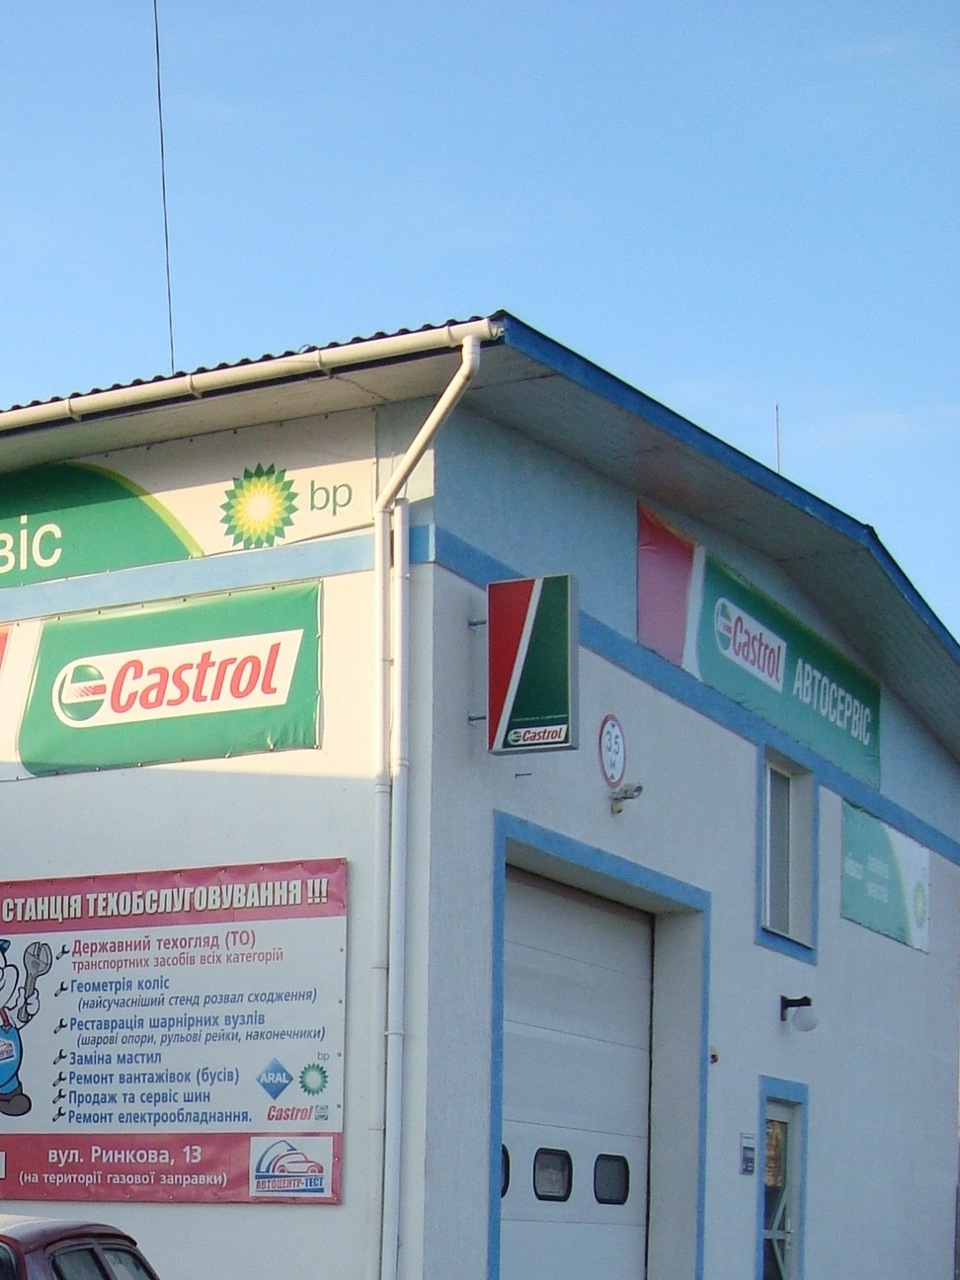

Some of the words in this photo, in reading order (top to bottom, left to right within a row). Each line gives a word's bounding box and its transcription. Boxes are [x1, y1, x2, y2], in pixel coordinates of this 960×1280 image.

[309, 478, 353, 517] bp
[733, 615, 781, 684] Castrol
[110, 642, 282, 713] Castrol
[793, 658, 872, 746] АВТОСЕРВІС
[521, 726, 562, 742] Castrol
[2, 894, 82, 923] СТАНЦІЯ
[86, 879, 302, 918] ТЕХОБСЛУГОВУВАННЯ
[72, 935, 151, 958] Державний
[156, 934, 220, 951] техогляд
[225, 930, 256, 951] (ТО)
[72, 957, 149, 975] транспортних
[153, 951, 196, 967] засобів
[200, 950, 222, 965] всіх
[226, 947, 284, 966] категорій
[70, 977, 133, 995] Геометрія
[137, 975, 170, 991] коліс
[77, 993, 165, 1012] (найсучасніший
[168, 994, 200, 1006] стенд
[203, 993, 244, 1008] розвал
[247, 987, 317, 1004] сходження)
[70, 1014, 144, 1033] Реставрація
[149, 1013, 219, 1031] шарнірних
[224, 1010, 266, 1029] вузлів
[77, 1032, 119, 1048] (шарові
[121, 1033, 157, 1047] опори,
[160, 1029, 202, 1046] рульові
[204, 1028, 242, 1045] рейки,
[245, 1026, 326, 1042] наконечники)
[69, 1050, 112, 1065] Заміна
[116, 1052, 162, 1065] мастил
[317, 1051, 330, 1061] bp
[69, 1070, 115, 1085] Ремонт
[118, 1069, 192, 1085] вантажівок
[196, 1067, 240, 1086] (бусів)
[259, 1071, 290, 1084] ARAL
[68, 1089, 118, 1107] Продаж
[122, 1092, 136, 1104] та
[140, 1088, 179, 1107] сервіс
[183, 1091, 211, 1103] шин
[68, 1109, 114, 1124] Ремонт
[118, 1108, 252, 1126] електрообладнання.
[267, 1105, 314, 1121] Castrol
[48, 1148, 84, 1167] вул.
[91, 1145, 176, 1166] Ринкова,
[182, 1145, 202, 1164] 13
[19, 1171, 39, 1186] (на
[43, 1171, 102, 1187] території
[106, 1171, 155, 1185] газової
[159, 1171, 228, 1188] заправки)
[256, 1177, 324, 1189] АВТОЦЕНТР-ТЕСТ
